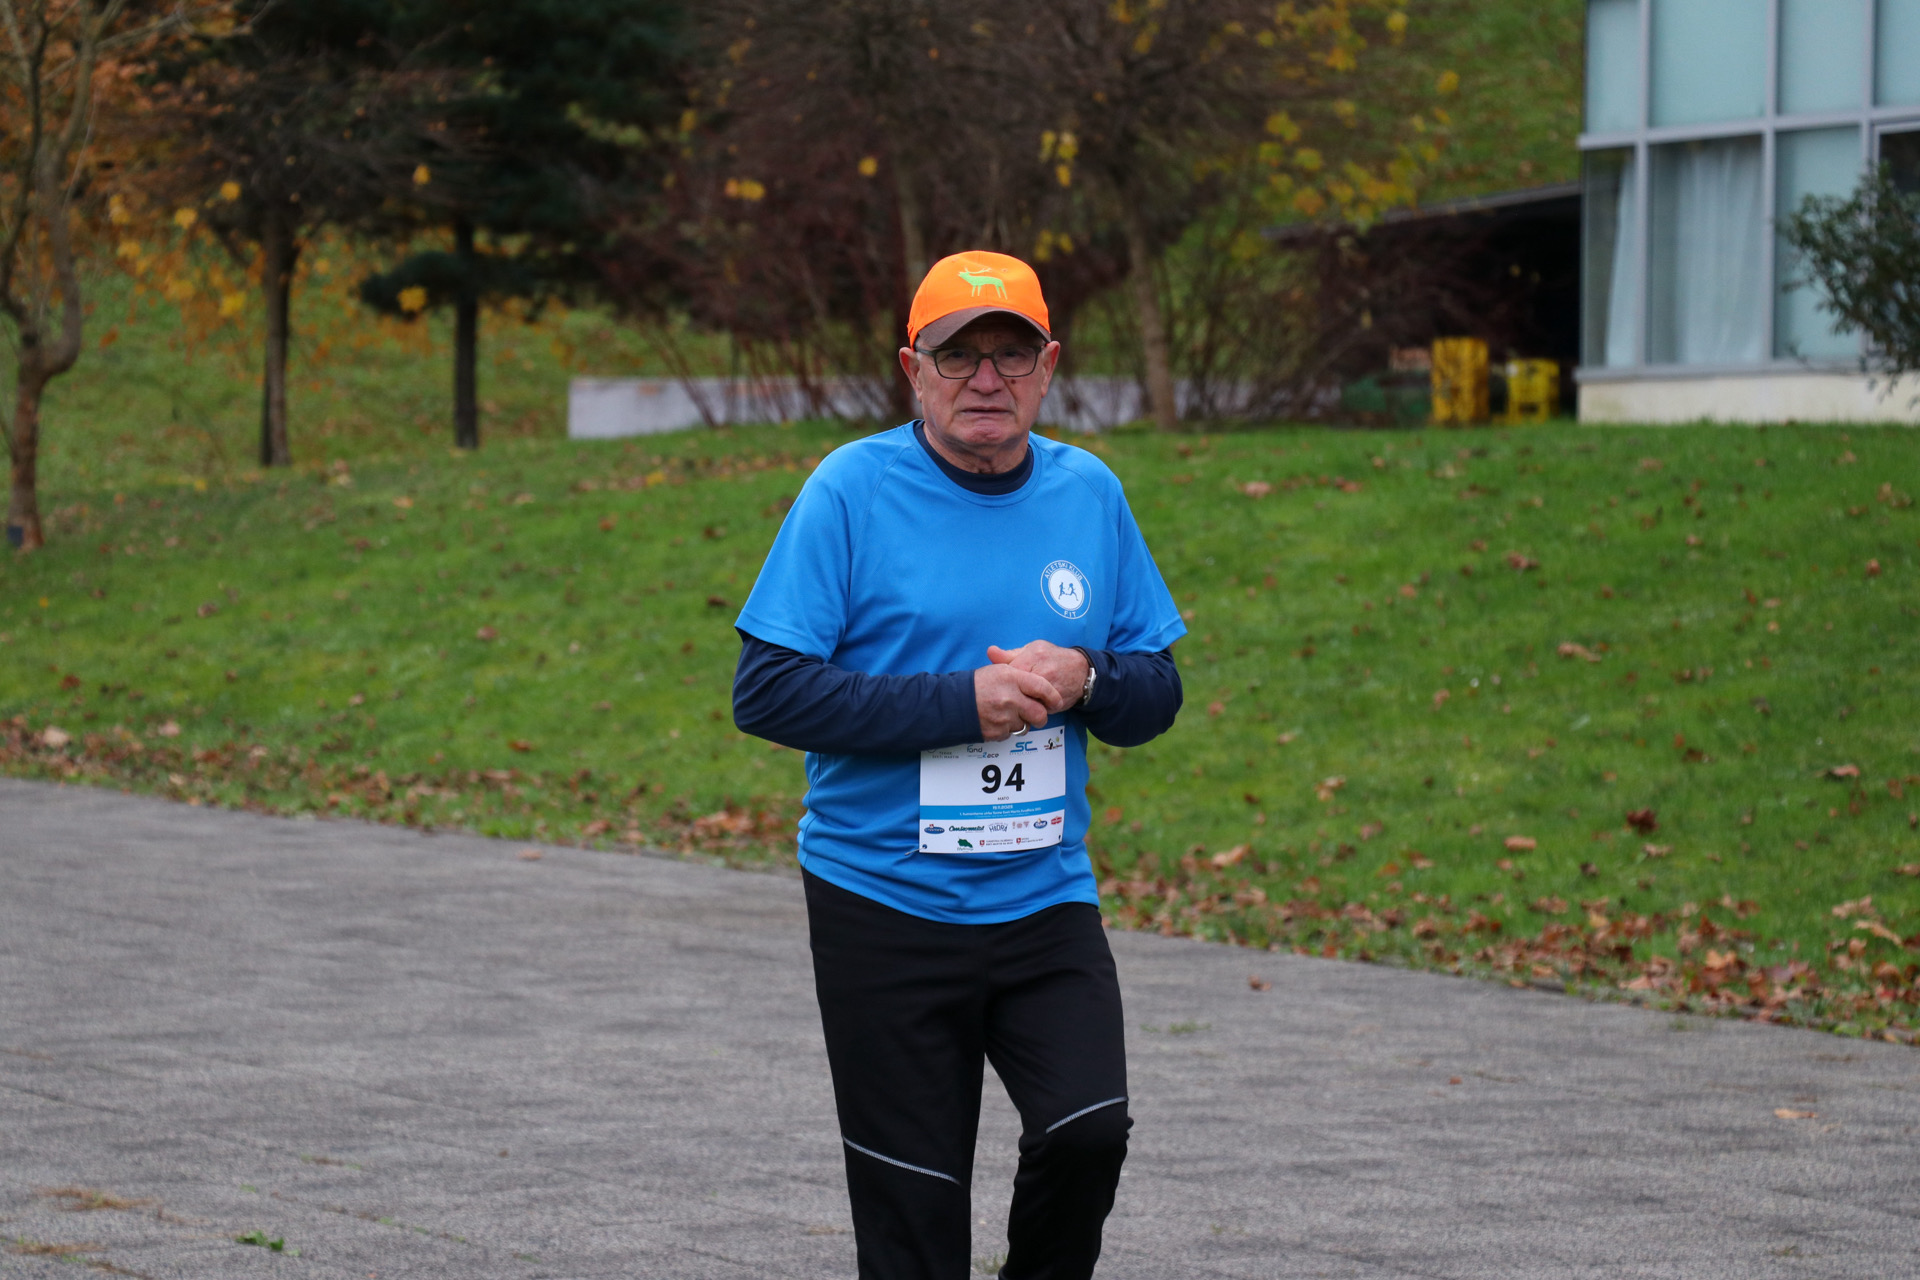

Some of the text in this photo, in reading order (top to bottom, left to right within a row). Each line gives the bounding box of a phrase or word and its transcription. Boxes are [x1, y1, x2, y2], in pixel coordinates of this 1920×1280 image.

[1044, 562, 1083, 581] ATLETSKI KLUB
[1064, 610, 1077, 618] FIT
[1010, 741, 1038, 753] SC
[981, 763, 1025, 794] 94
